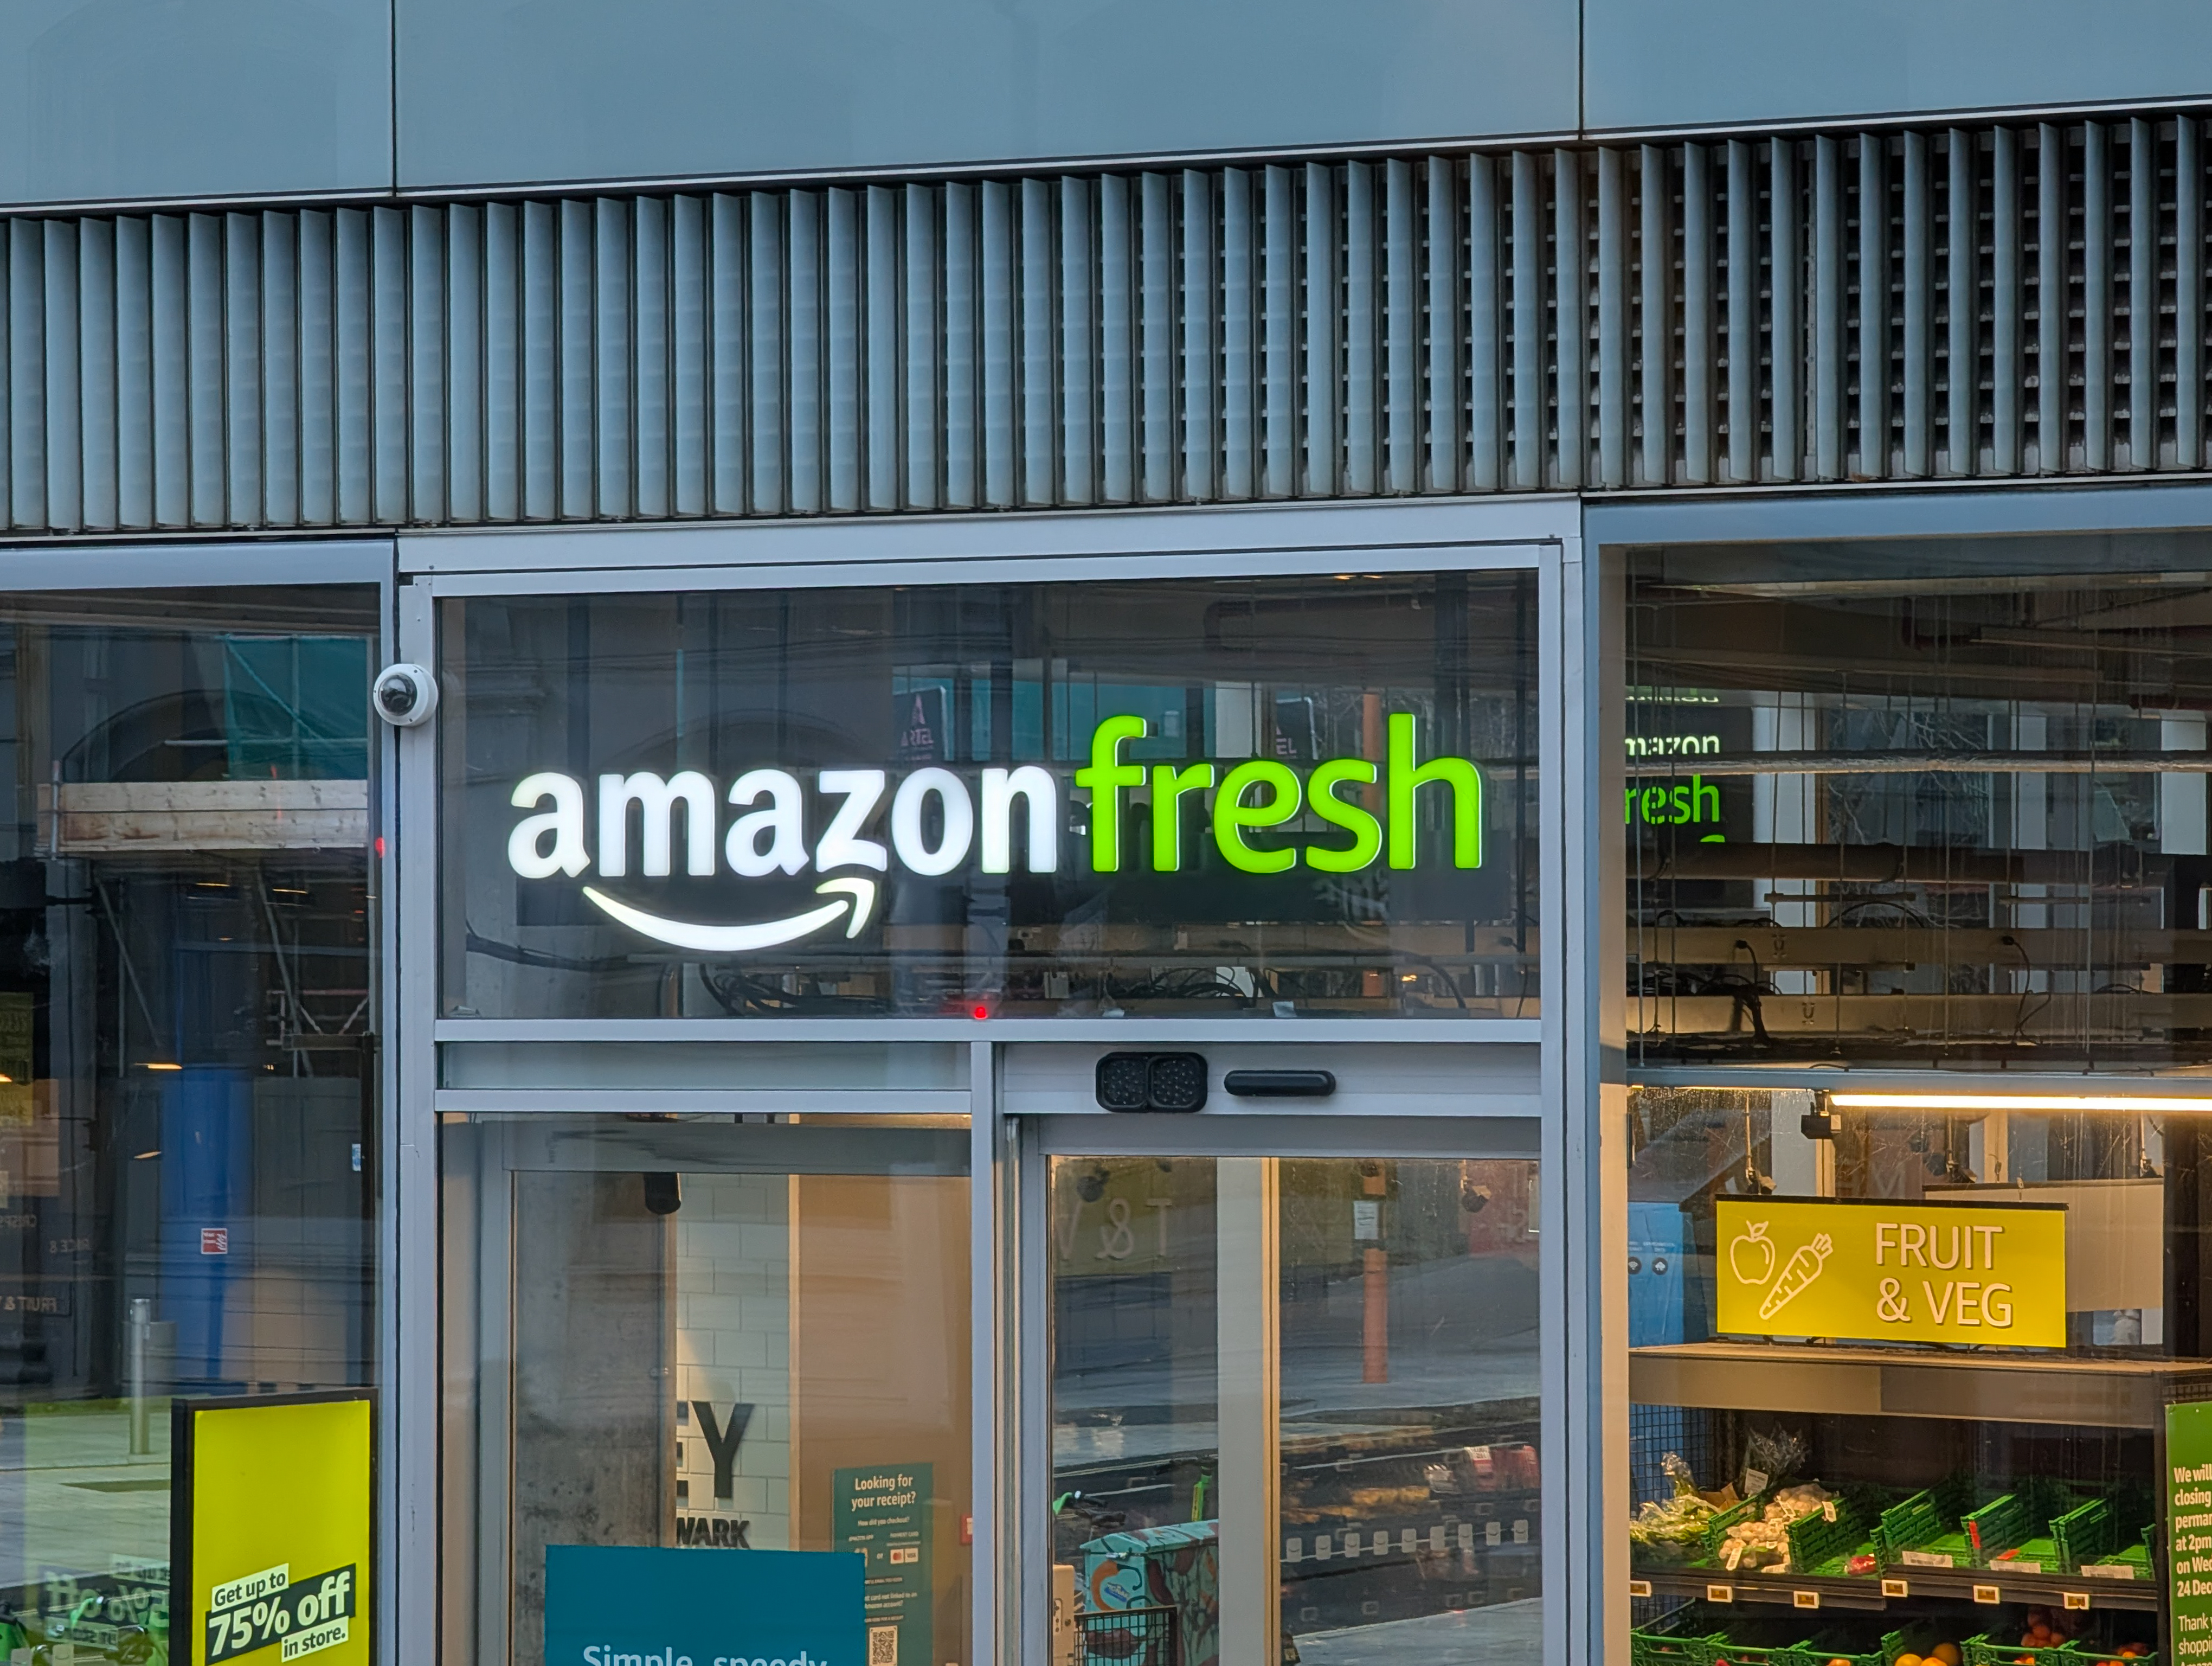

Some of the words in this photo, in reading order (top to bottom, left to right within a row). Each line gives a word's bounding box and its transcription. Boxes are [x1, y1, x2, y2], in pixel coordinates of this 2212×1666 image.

[507, 765, 1057, 879] amazon
[1075, 713, 1482, 873] fresh
[1876, 1223, 2003, 1270] FRUIT
[1877, 1277, 1911, 1322] &
[1922, 1280, 2012, 1327] VEG
[855, 1475, 895, 1491] Looking
[897, 1473, 913, 1486] for
[2174, 1466, 2191, 1483] We
[2192, 1463, 2212, 1482] will
[851, 1497, 875, 1512] your
[877, 1491, 916, 1508] receipt?
[2174, 1486, 2211, 1508] closing
[2176, 1536, 2187, 1552] at
[2188, 1534, 2212, 1554] 2pm
[2176, 1561, 2190, 1574] on
[215, 1584, 242, 1606] Get
[246, 1579, 266, 1599] up
[269, 1573, 286, 1588] to
[2177, 1580, 2191, 1597] 24
[209, 1596, 290, 1656] 75%
[297, 1571, 350, 1626] off
[2178, 1612, 2209, 1632] Thank
[284, 1639, 299, 1658] in
[302, 1626, 346, 1652] store.
